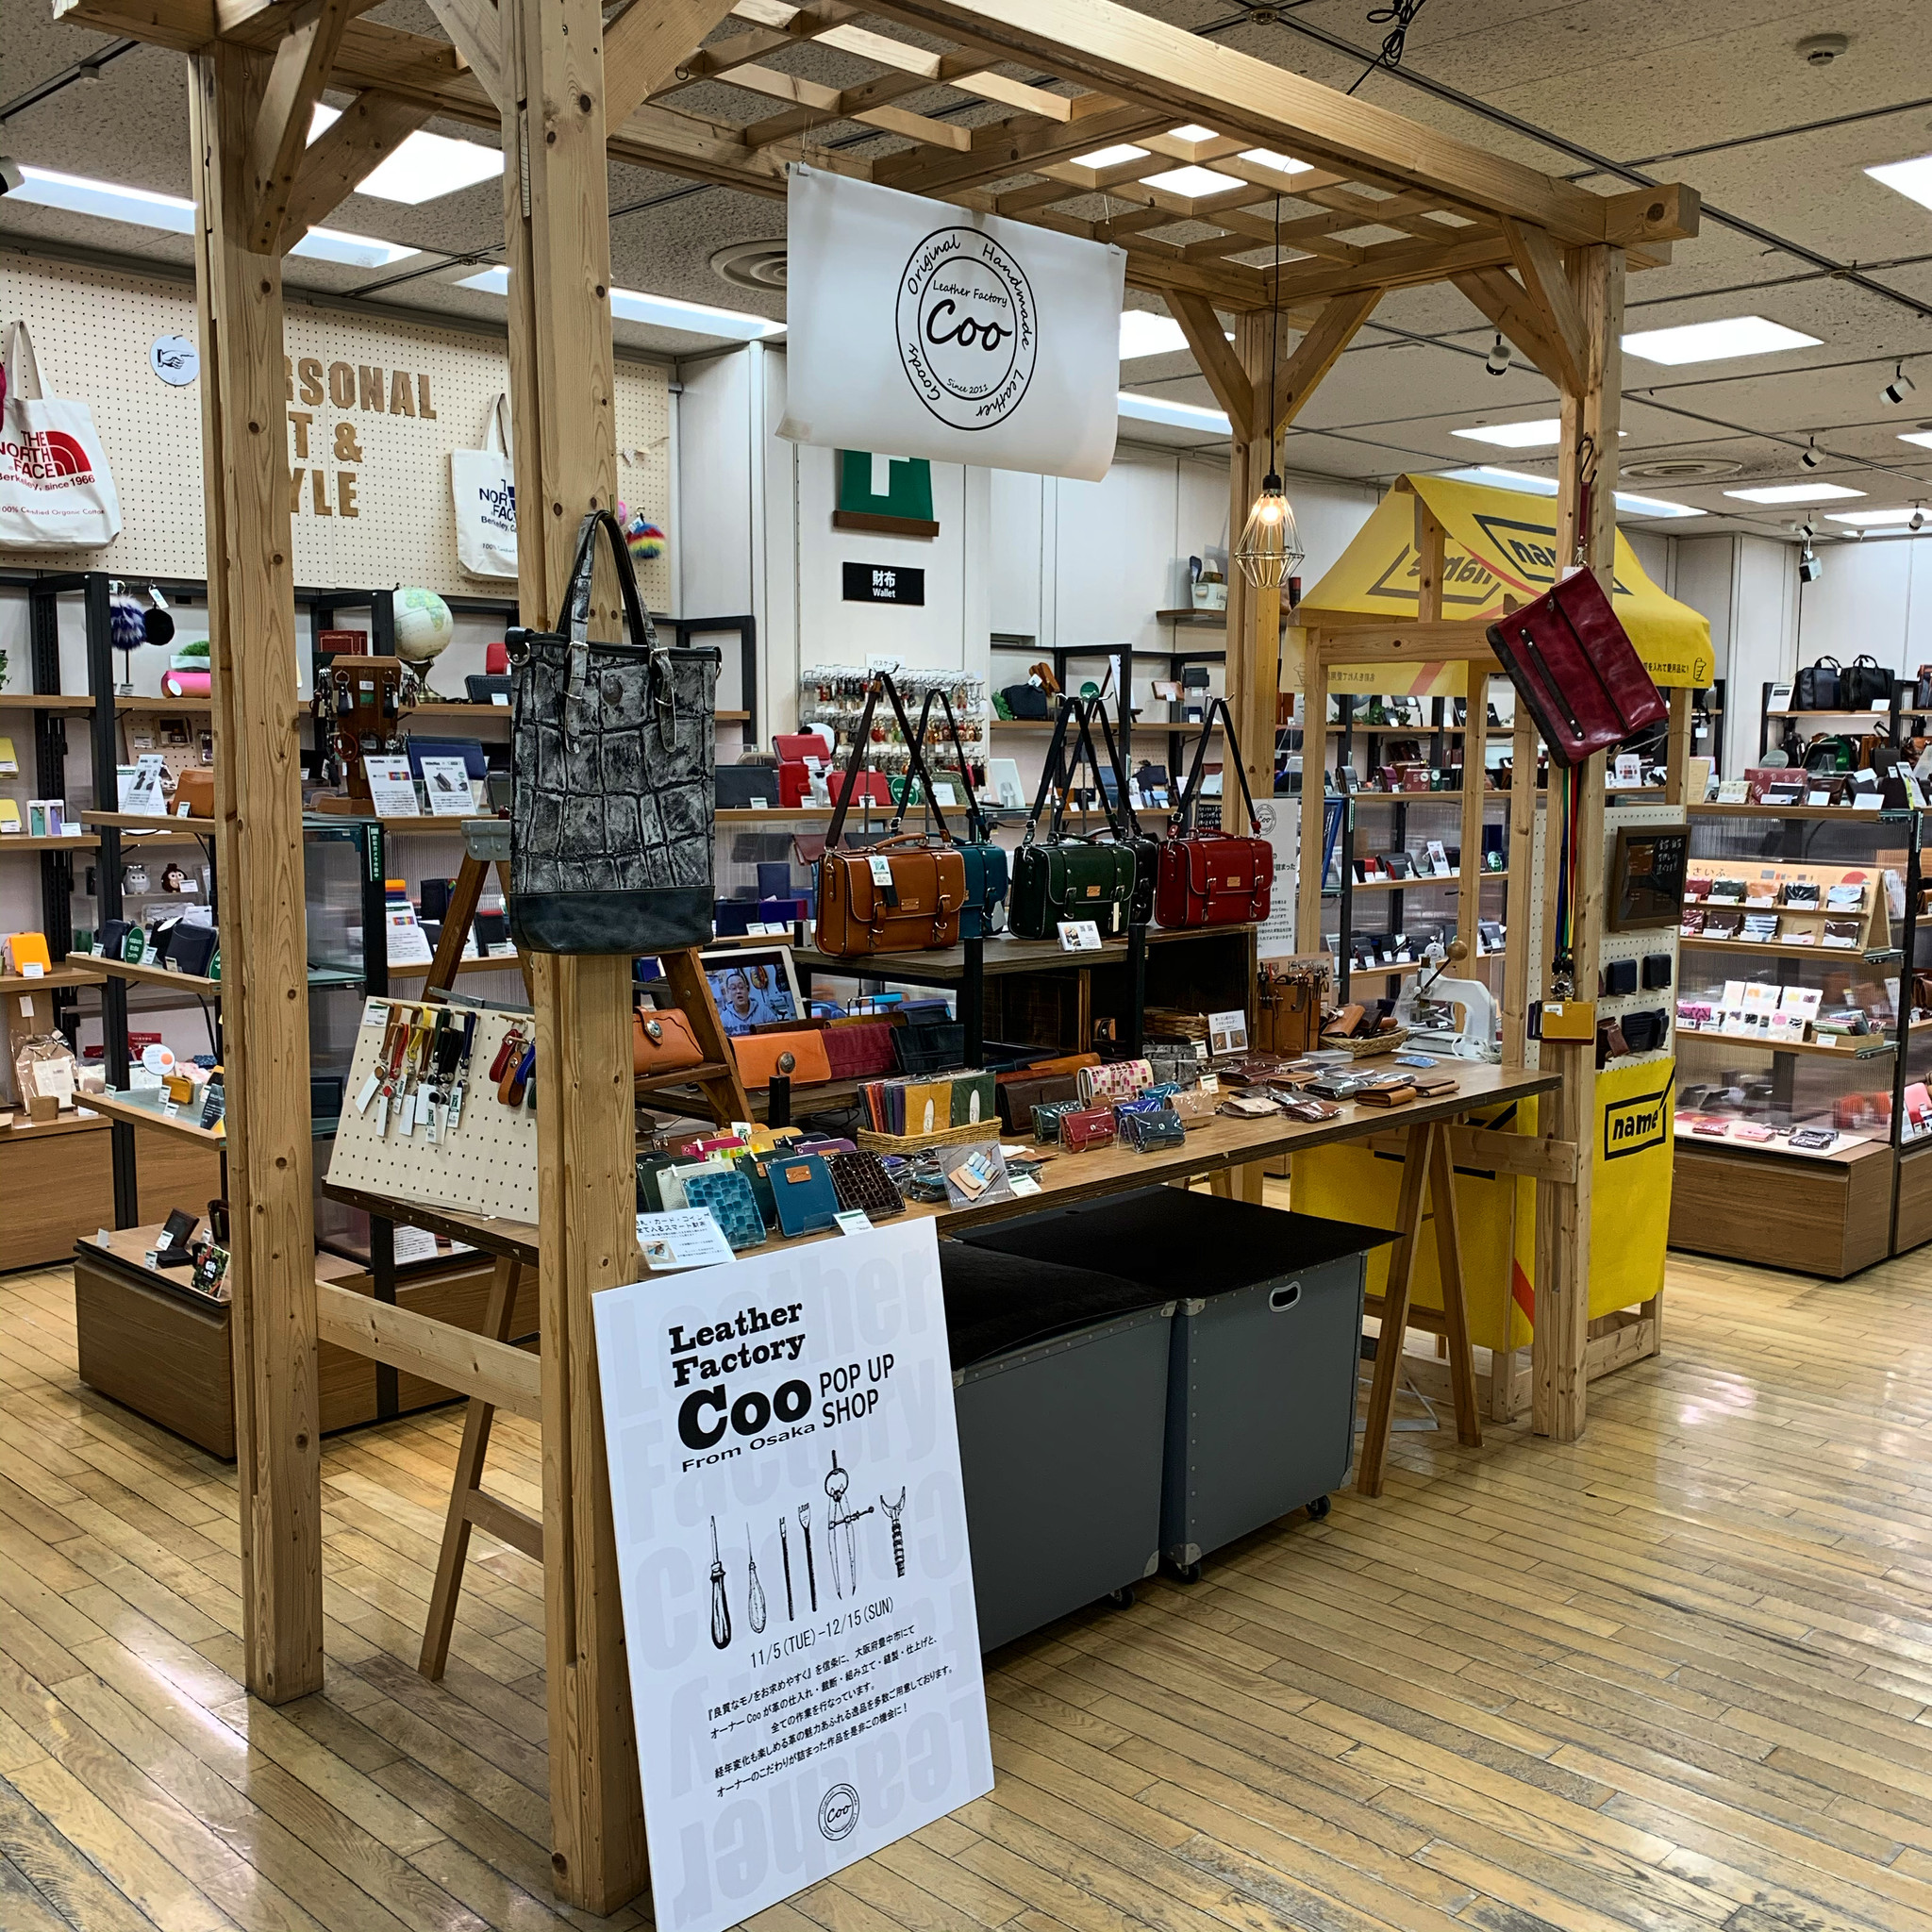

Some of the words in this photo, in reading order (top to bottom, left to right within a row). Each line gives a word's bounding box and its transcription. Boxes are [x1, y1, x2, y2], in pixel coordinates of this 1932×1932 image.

[908, 234, 960, 294] Original
[933, 279, 971, 297] Leather
[974, 288, 1008, 308] Factory
[982, 242, 1033, 351] Handmade
[926, 298, 1012, 351] Coo
[908, 342, 941, 401] Goods
[946, 377, 968, 393] Since
[969, 383, 989, 394] 2011
[975, 369, 1024, 417] Leather
[20, 430, 47, 447] THE
[334, 422, 363, 462] &
[13, 458, 56, 479] FACE
[44, 482, 69, 491] since
[70, 475, 95, 487] 1966
[872, 570, 896, 588] 財布
[872, 588, 896, 598] Wallet
[1611, 1107, 1659, 1141] name
[668, 1303, 803, 1355] Leather
[672, 1333, 807, 1388] Factory
[820, 1363, 861, 1397] POP
[868, 1353, 894, 1382] UP
[678, 1379, 812, 1450] Coo
[822, 1389, 879, 1428] SHOP
[682, 1446, 741, 1473] From
[749, 1424, 816, 1451] Osaka
[771, 1681, 875, 1735] 全ての作業を行なっています。
[826, 1804, 852, 1824] Coo
